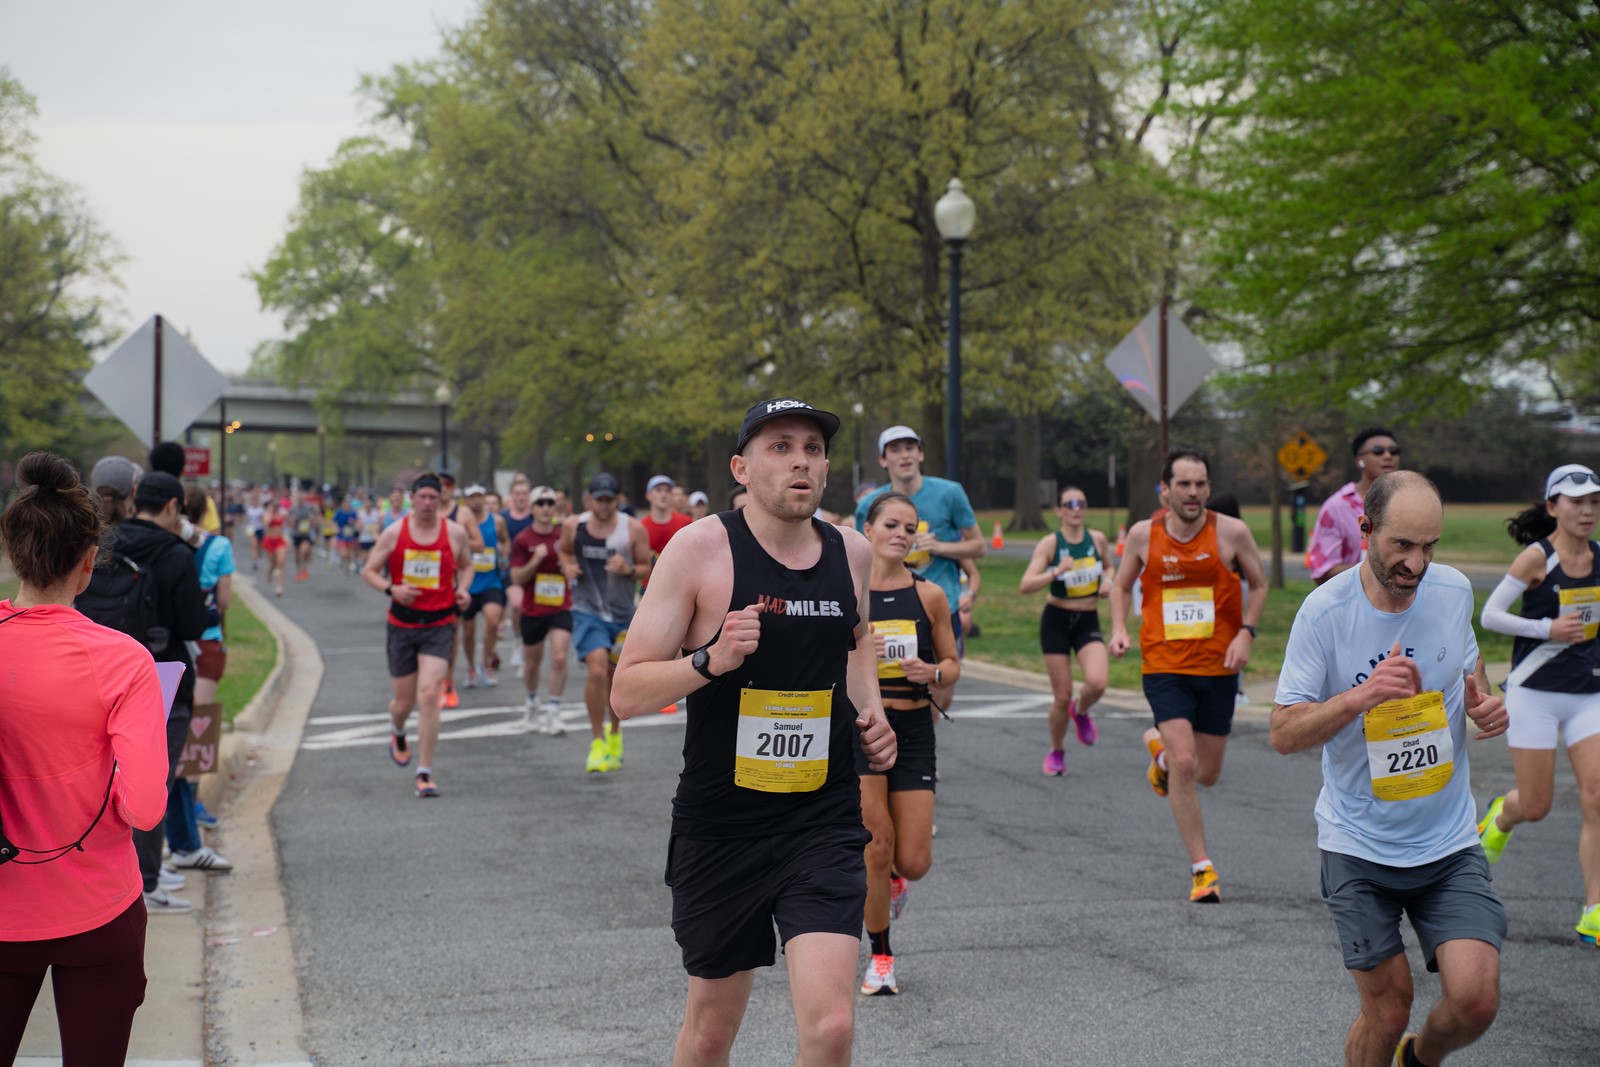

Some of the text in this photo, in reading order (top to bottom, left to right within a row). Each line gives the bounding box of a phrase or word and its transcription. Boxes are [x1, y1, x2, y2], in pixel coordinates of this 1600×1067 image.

[1174, 609, 1204, 621] 1576
[773, 722, 803, 731] Samuel
[756, 732, 814, 758] 2007
[1403, 739, 1420, 748] Chad
[1387, 744, 1438, 773] 2220
